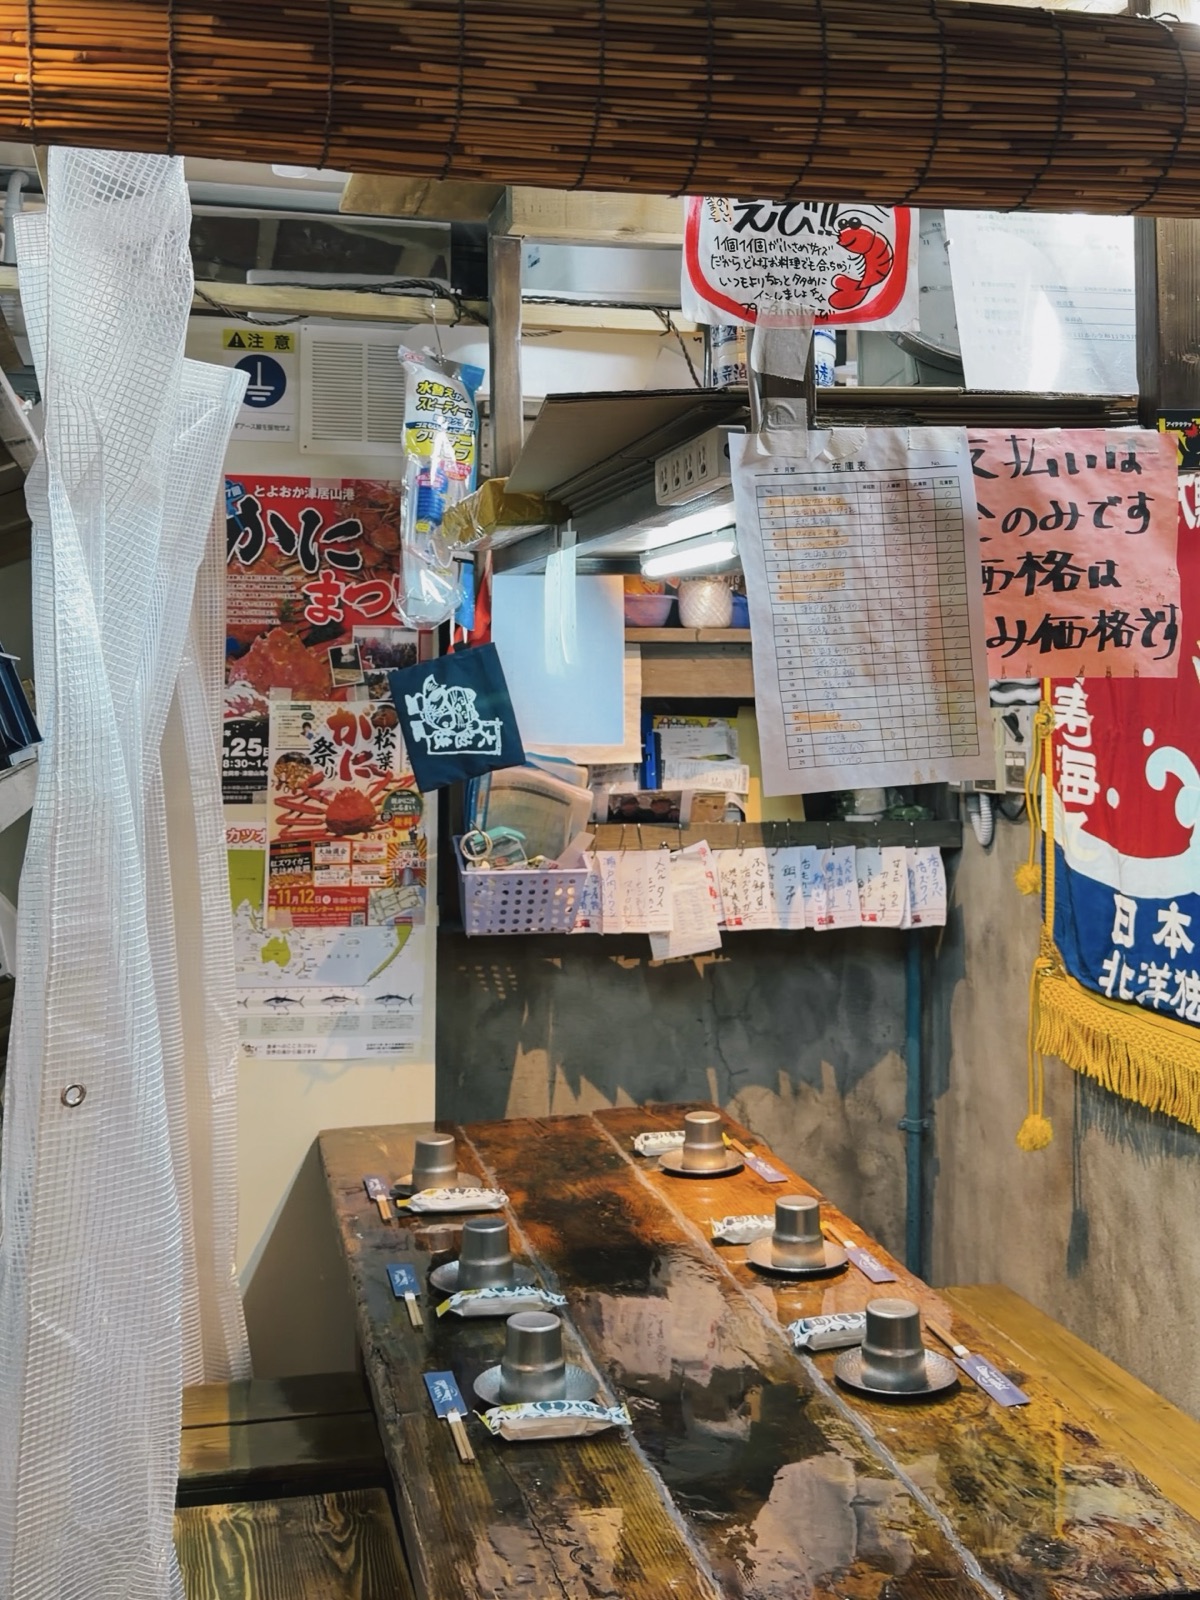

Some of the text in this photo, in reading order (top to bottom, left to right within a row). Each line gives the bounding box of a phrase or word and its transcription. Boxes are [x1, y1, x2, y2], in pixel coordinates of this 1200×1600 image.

[248, 333, 290, 349] 注意
[832, 461, 867, 472] 在庫表
[255, 485, 355, 500] とよおか津居山港
[227, 494, 363, 573] かに
[309, 736, 338, 779] 祭り
[326, 707, 373, 781] かに
[374, 728, 397, 771] 松葉
[1111, 893, 1195, 959] 日本
